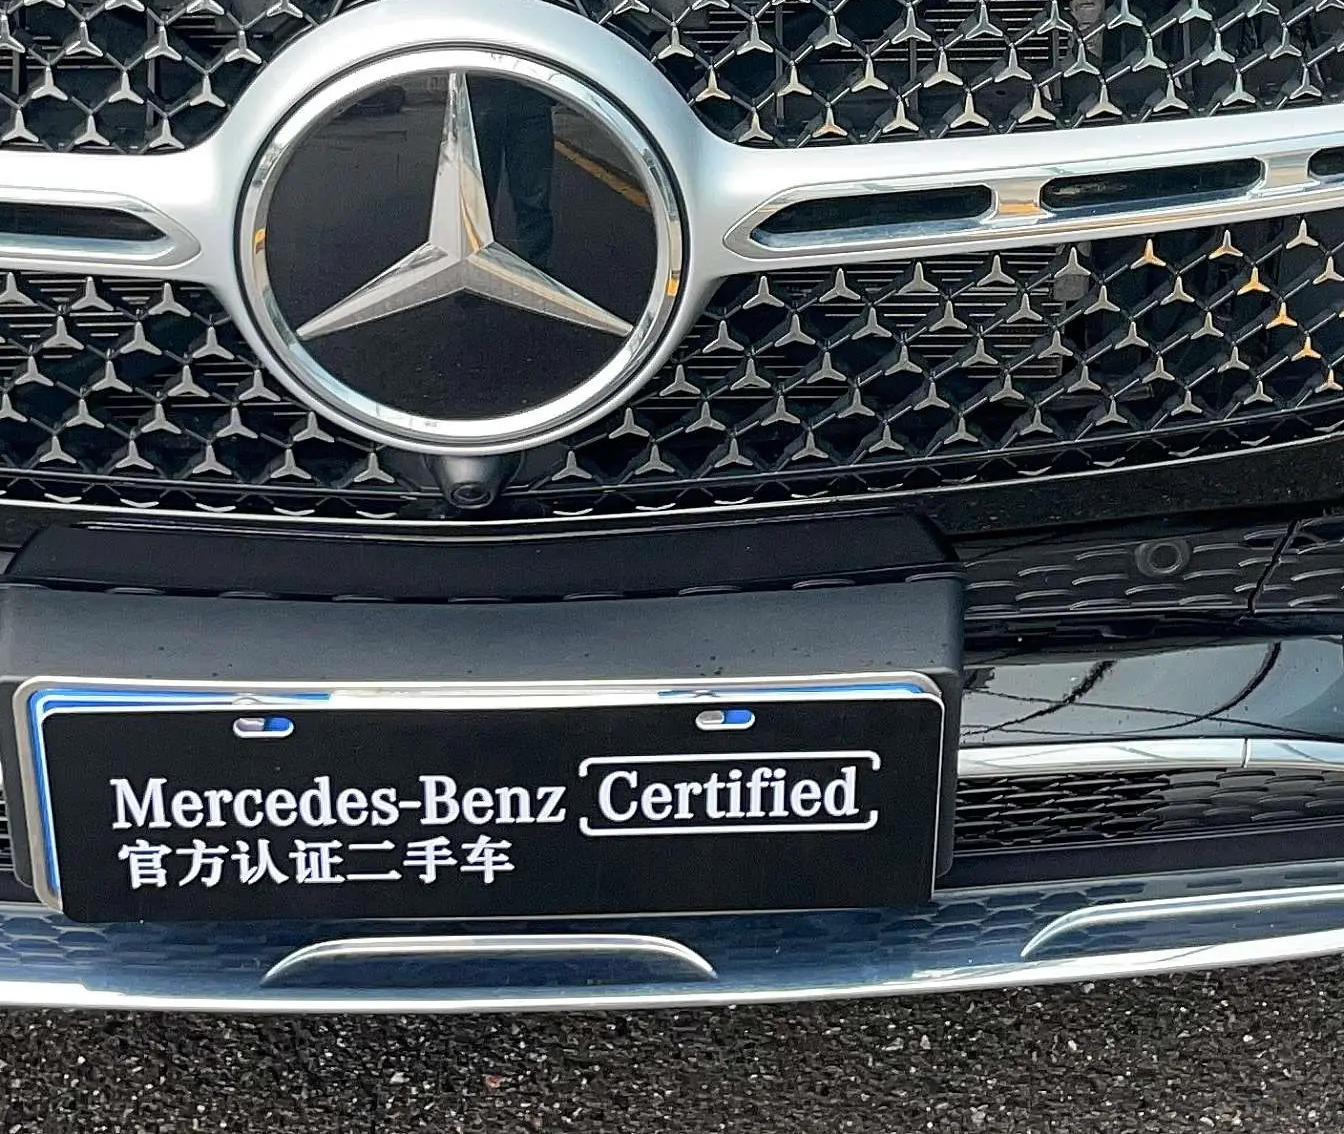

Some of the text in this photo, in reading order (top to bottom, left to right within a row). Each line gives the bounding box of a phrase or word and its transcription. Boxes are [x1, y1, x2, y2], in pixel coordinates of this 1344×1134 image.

[109, 765, 860, 830] Mercedes-Benz Certified
[117, 834, 516, 890] 官方认证二手车
